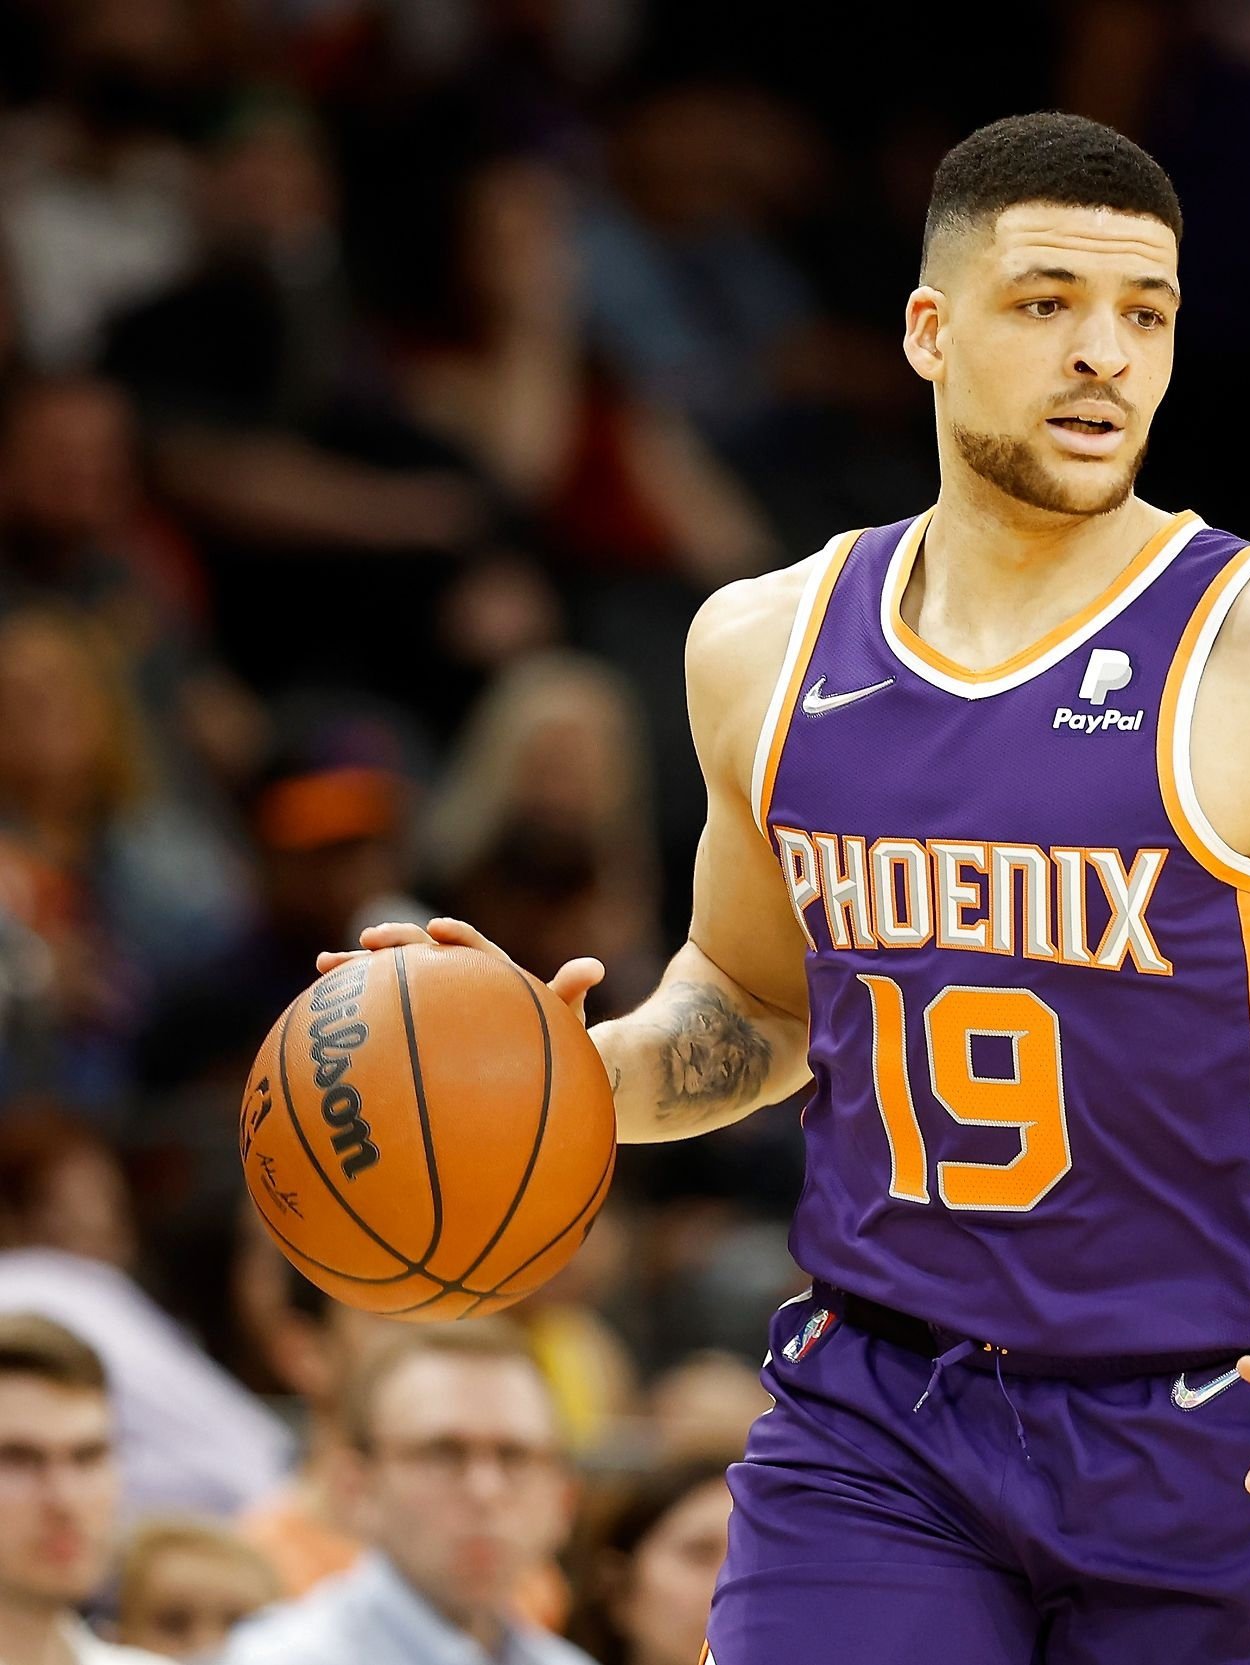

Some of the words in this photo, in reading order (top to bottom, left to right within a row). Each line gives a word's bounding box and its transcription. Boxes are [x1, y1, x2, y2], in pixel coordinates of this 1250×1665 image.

[1052, 707, 1145, 734] PayPal
[772, 825, 1174, 977] PHOENIX
[856, 973, 1073, 1212] 19
